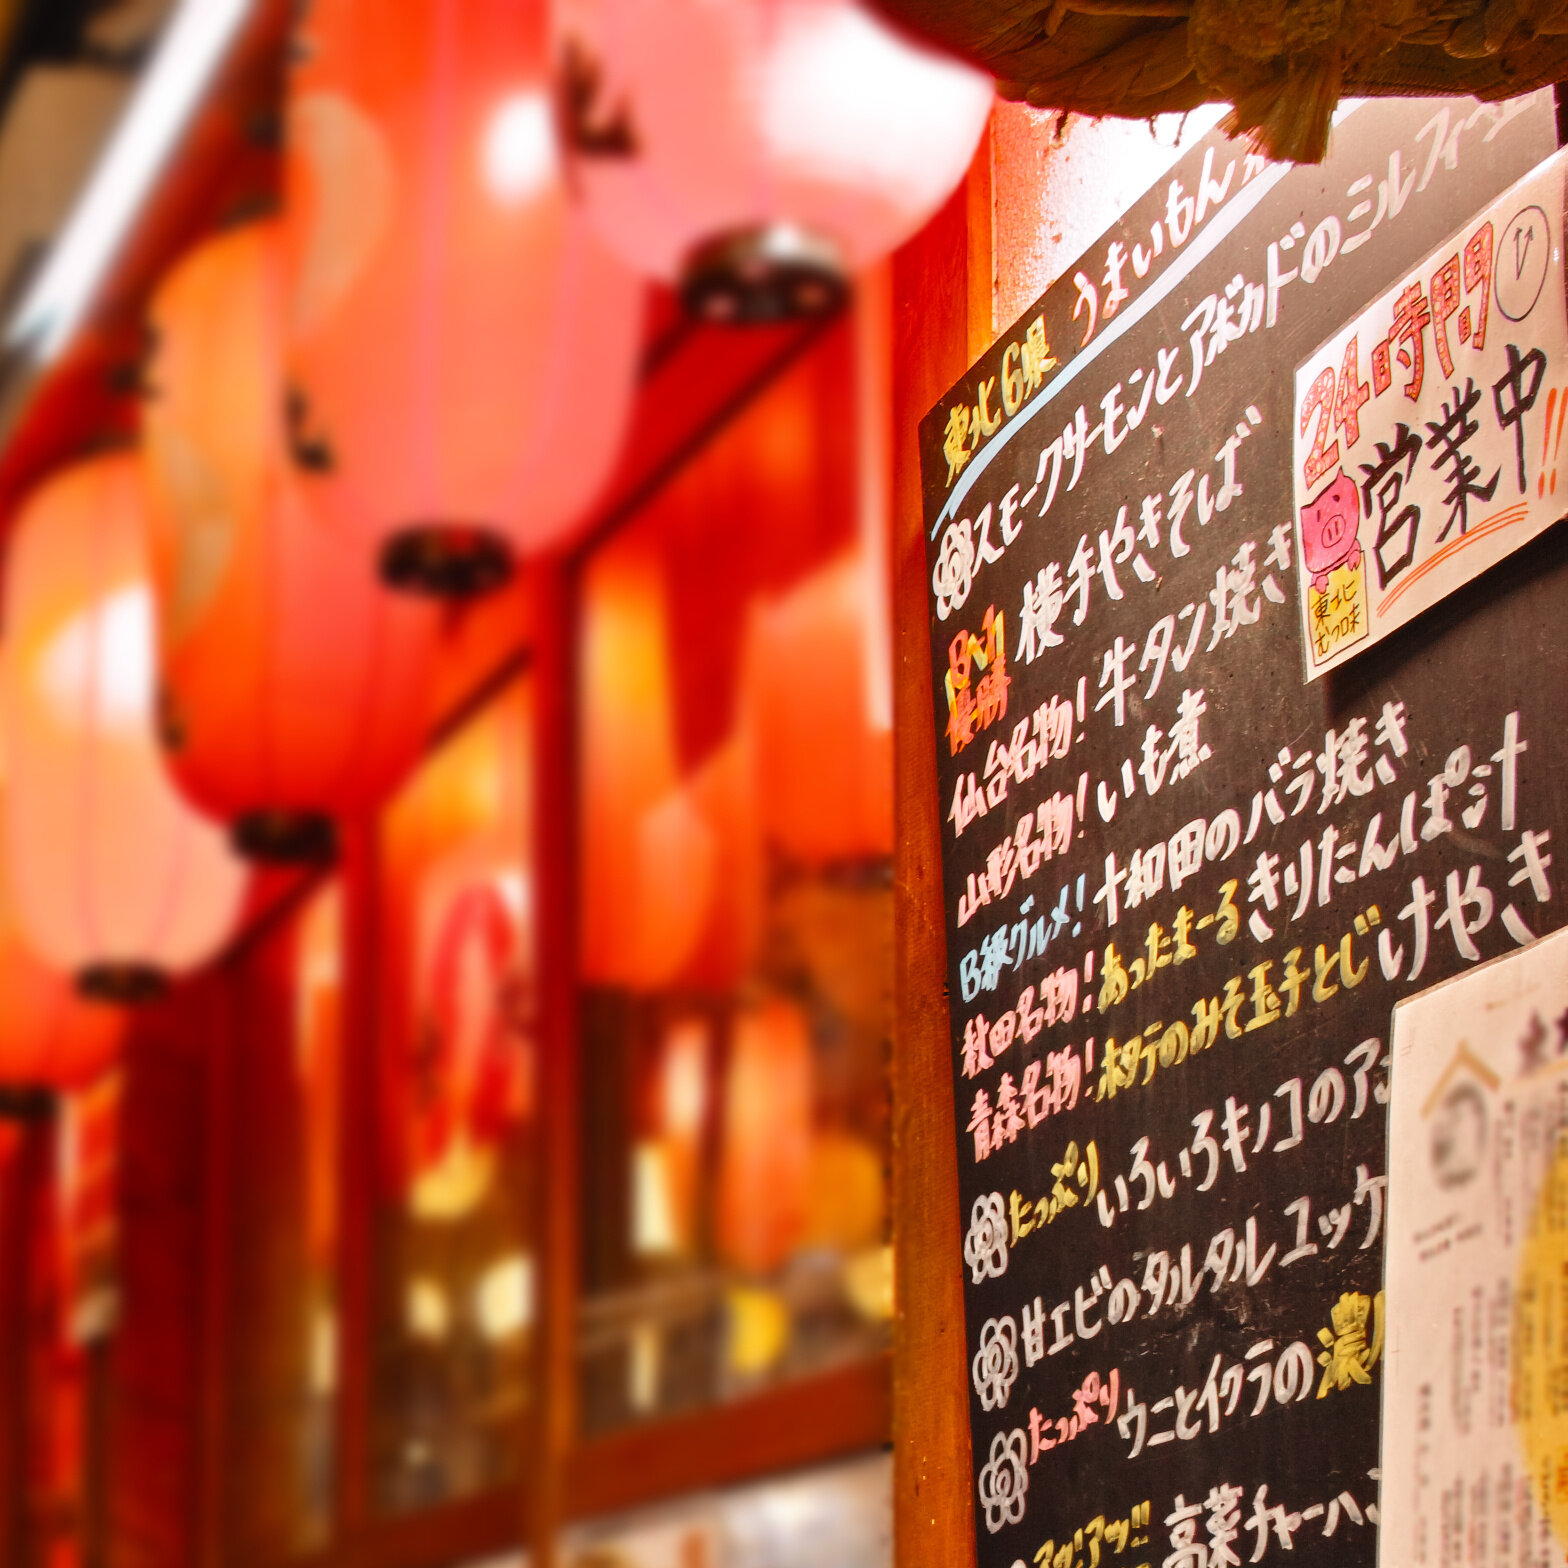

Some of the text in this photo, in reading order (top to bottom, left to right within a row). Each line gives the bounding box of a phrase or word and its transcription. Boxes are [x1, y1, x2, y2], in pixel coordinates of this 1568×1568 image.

[944, 315, 1057, 488] 東北6県
[1299, 220, 1493, 490] 24時間
[1015, 405, 1262, 665] 横手やきそば
[947, 521, 1291, 839] 仙台名物! 牛タン焼き
[1097, 688, 1213, 823] いも煮
[960, 701, 1409, 1003] B級グルメ! 十和田のバラ焼き
[961, 950, 1094, 1080] 秋田名物!
[1010, 1139, 1099, 1249] たっぷり
[1028, 1368, 1119, 1466] たっぷり
